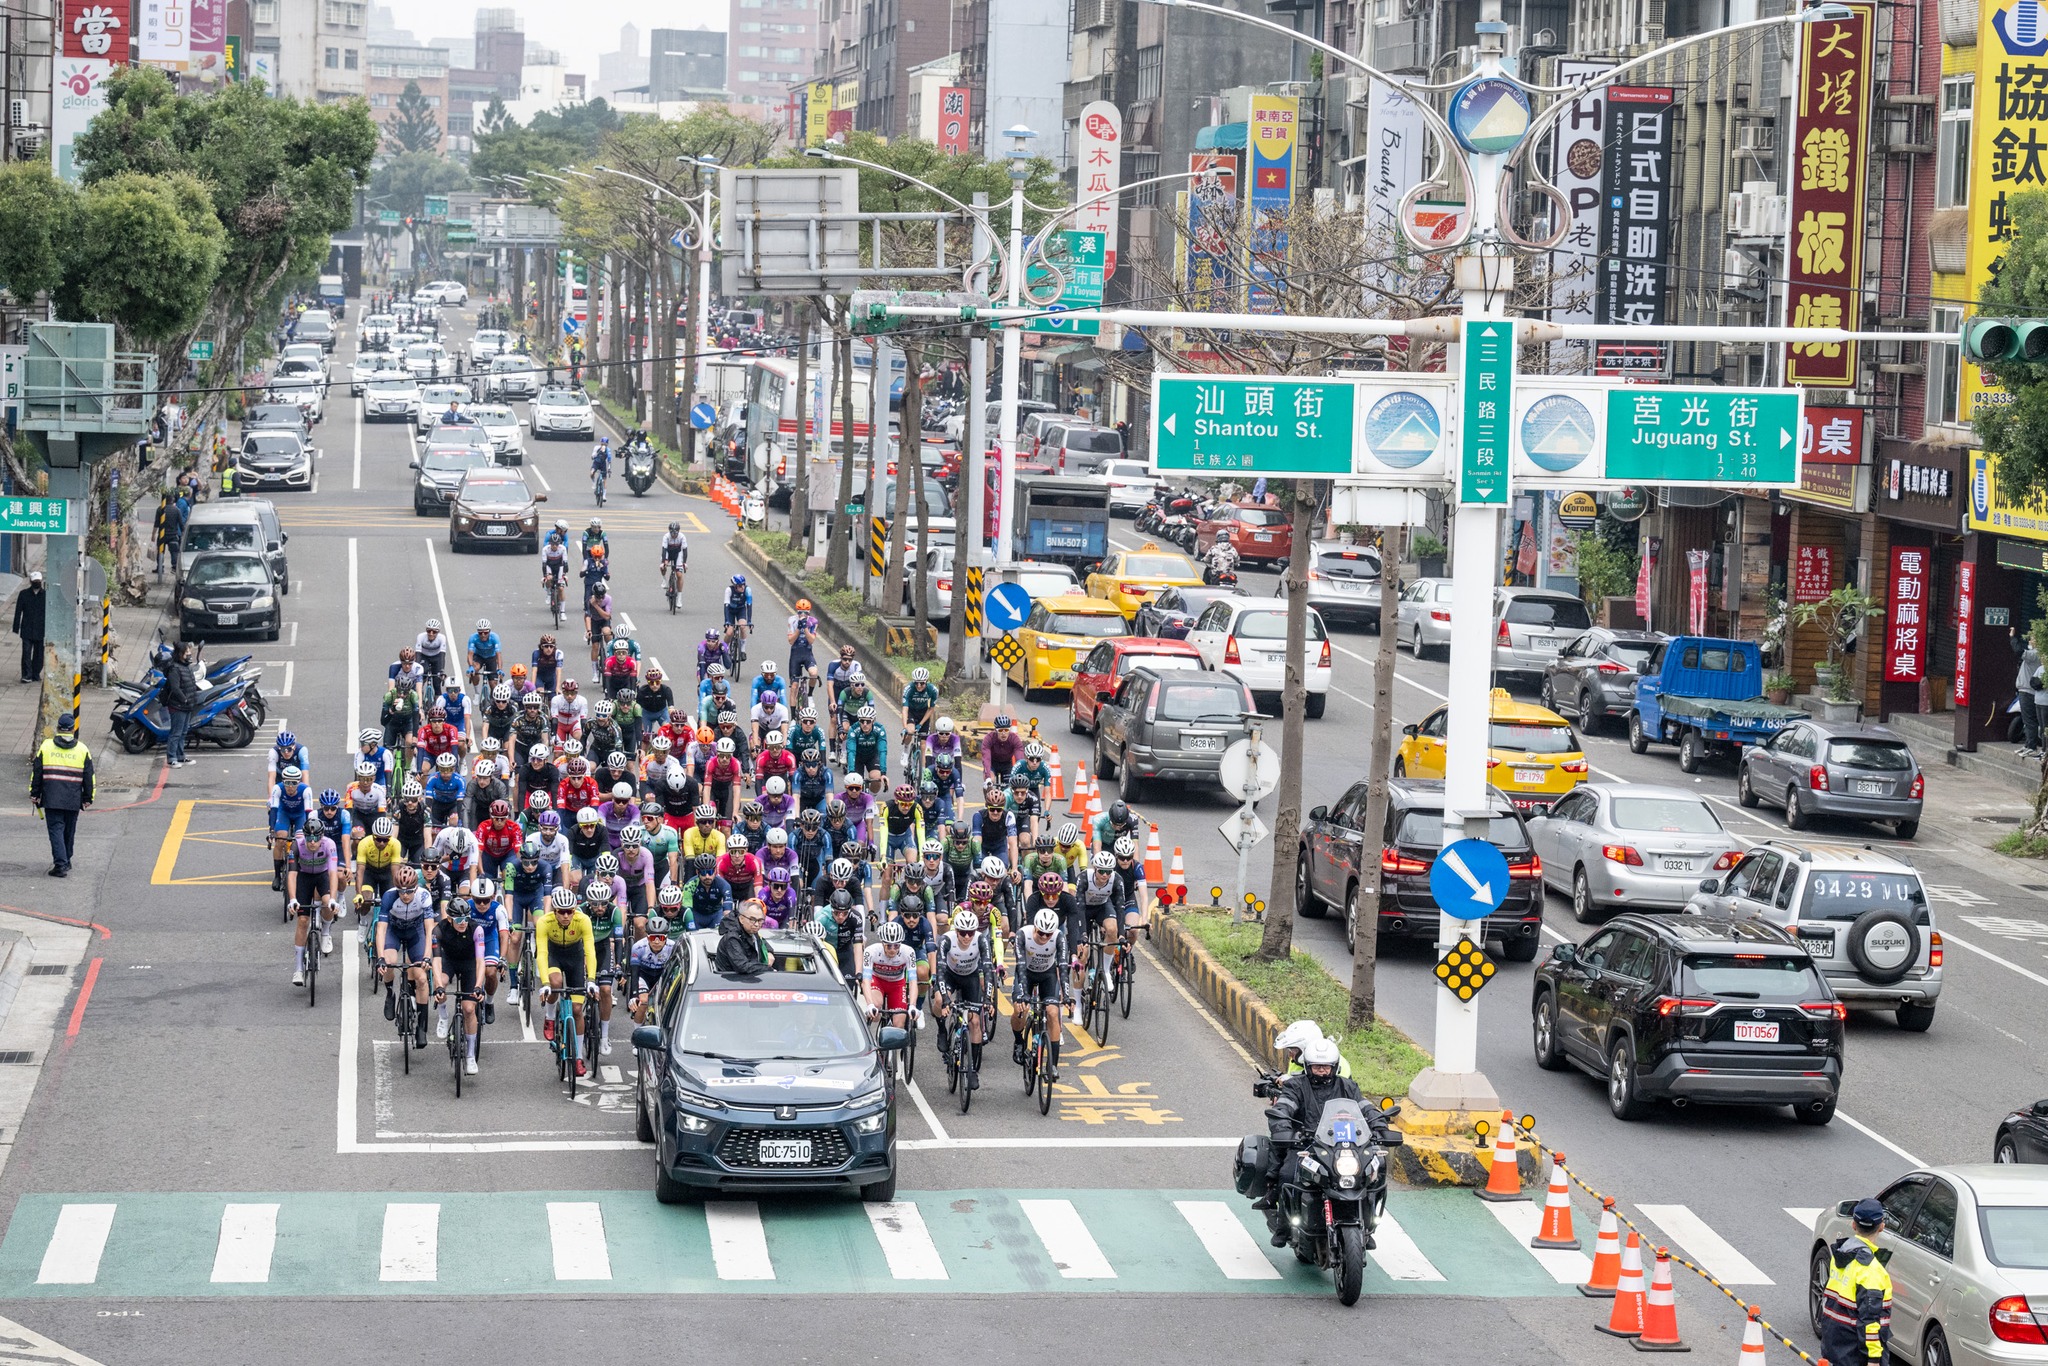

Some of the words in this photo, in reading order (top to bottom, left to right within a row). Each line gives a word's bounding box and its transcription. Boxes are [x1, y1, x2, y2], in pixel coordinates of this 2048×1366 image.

[73, 5, 121, 55] 當
[63, 95, 98, 109] gloria
[1256, 110, 1293, 123] 東南亞
[1261, 127, 1288, 140] 百貨
[1623, 112, 1663, 325] 日式自助洗衣
[1195, 384, 1325, 419] 汕頭街
[1476, 344, 1498, 467] 三民路三段
[1632, 395, 1758, 428] 莒光街
[1194, 419, 1279, 438] Shantou
[1295, 421, 1323, 438] St.
[1193, 439, 1200, 450] 1
[1632, 428, 1718, 450] Juguang
[1729, 431, 1758, 447] St.
[1193, 453, 1254, 467] 民族公園
[1717, 453, 1723, 464] 1
[1741, 453, 1757, 464] 33
[1716, 466, 1724, 478] 2
[1740, 466, 1757, 478] 40
[9, 501, 62, 517] 建興街
[1563, 502, 1595, 514] Corona
[1611, 501, 1643, 510] Heineken
[11, 518, 47, 529] Jianxing
[49, 519, 60, 528] St.
[1893, 551, 1922, 676] 電動麻將桌
[51, 751, 77, 761] POLICE
[1814, 879, 1872, 899] 9428
[704, 992, 734, 1001] Race
[738, 991, 787, 1001] Director
